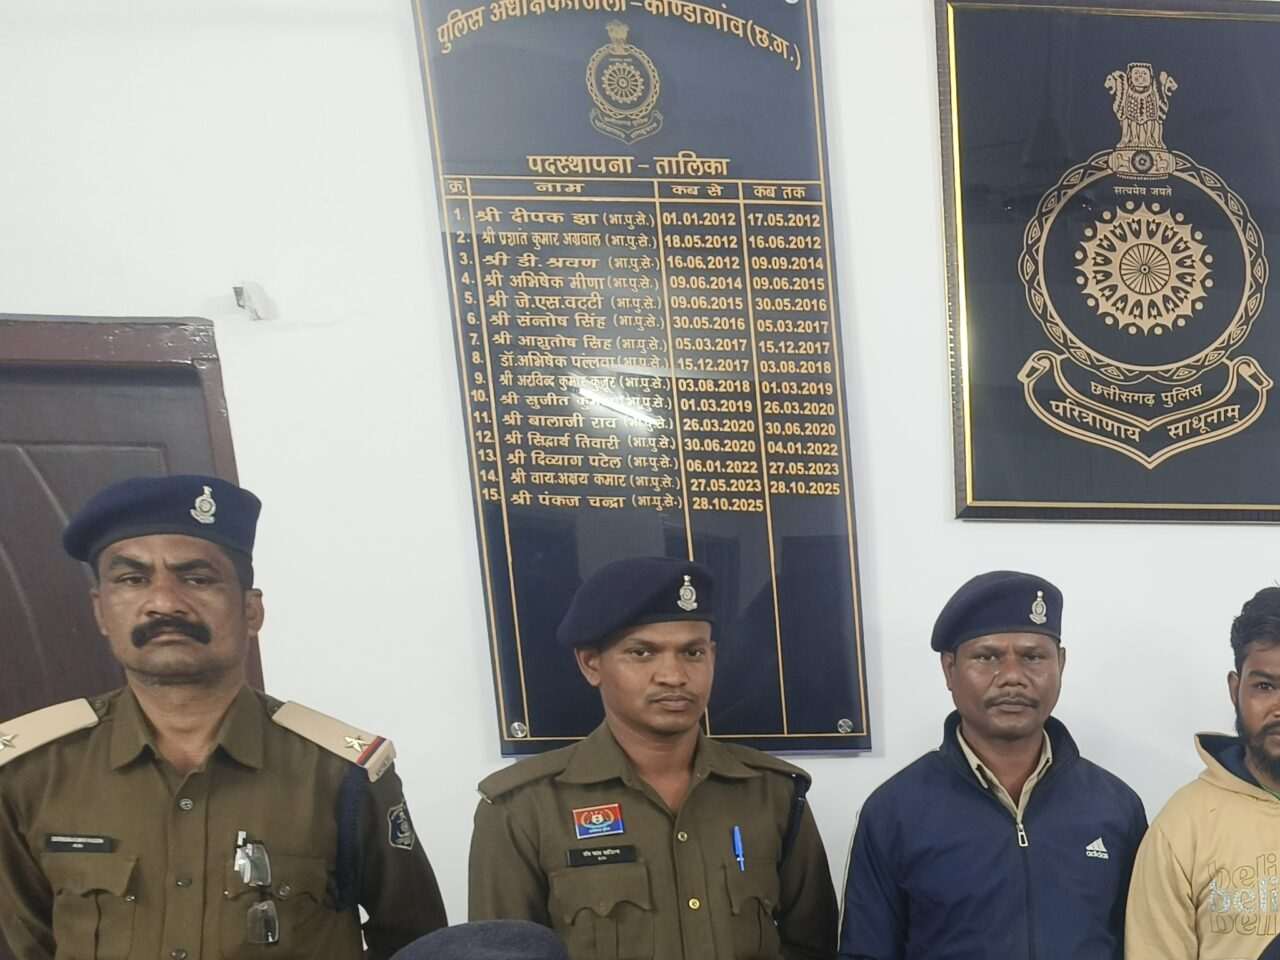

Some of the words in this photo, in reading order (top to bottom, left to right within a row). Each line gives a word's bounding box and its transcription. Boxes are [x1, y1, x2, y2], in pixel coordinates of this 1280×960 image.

[526, 155, 634, 174] पदस्थापना
[653, 151, 731, 176] तालिका
[534, 182, 585, 192] नाम
[672, 185, 700, 195] कब
[707, 184, 723, 197] से
[753, 186, 776, 198] कब
[782, 187, 806, 198] तक
[476, 207, 502, 223] श्री
[511, 207, 564, 223] दीपक
[572, 213, 598, 225] झा
[663, 213, 736, 226] 01.01.2012
[747, 214, 820, 227] 17.05.2012
[482, 227, 496, 245] श्री
[533, 233, 559, 250] कुमार
[665, 235, 738, 248] 18.05.2012
[749, 236, 821, 249] 16.06.2012
[482, 252, 512, 267] श्री
[547, 257, 600, 268] श्रवण
[667, 256, 739, 269] 16.06.2012
[752, 257, 823, 269] 09.09.2014
[484, 270, 504, 287] श्री
[510, 272, 564, 288] अभिषेक
[568, 273, 605, 290] मीणा
[670, 276, 742, 289] 09.06.2014
[753, 277, 824, 290] 09.06.2015
[487, 290, 508, 307] श्री
[671, 297, 743, 309] 09.06.2015
[756, 298, 827, 311] 30.05.2016
[489, 311, 511, 327] श्री
[673, 317, 745, 329] 30.05.2016
[757, 320, 828, 333] 05.03.2017
[492, 331, 512, 346] श्री
[676, 338, 747, 350] 05.03.2017
[759, 341, 830, 354] 15.12.2017
[678, 358, 749, 371] 15.12.2017
[760, 361, 831, 373] 03.08.2018
[499, 371, 513, 386] श्री
[678, 379, 750, 392] 03.08.2018
[762, 382, 833, 395] 01.03.2019
[501, 392, 520, 405] श्री
[525, 393, 568, 409] सुजीत
[681, 399, 752, 412] 01.03.2019
[764, 402, 834, 415] 26.03.2020
[1161, 382, 1203, 408] पुलिस
[502, 412, 523, 426] श्री
[528, 413, 584, 428] बालाजी
[591, 417, 617, 428] राव
[683, 419, 754, 432] 26.03.2020
[766, 422, 836, 436] 30.06.2020
[1049, 399, 1142, 443] परित्राणाय
[504, 431, 524, 445] श्री
[575, 432, 620, 449] तिवारी
[684, 439, 755, 452] 30.06.2020
[768, 442, 838, 455] 04.01.2022
[507, 450, 527, 465] श्री
[590, 453, 622, 468] पटेल
[686, 460, 758, 473] 06.01.2022
[769, 462, 839, 475] 27.05.2023
[511, 468, 528, 484] श्री
[691, 479, 762, 492] 27.05.2023
[770, 482, 840, 495] 28.10.2025
[510, 491, 532, 505] श्री
[538, 491, 581, 506] पंकज
[693, 498, 763, 511] 28.10.2025
